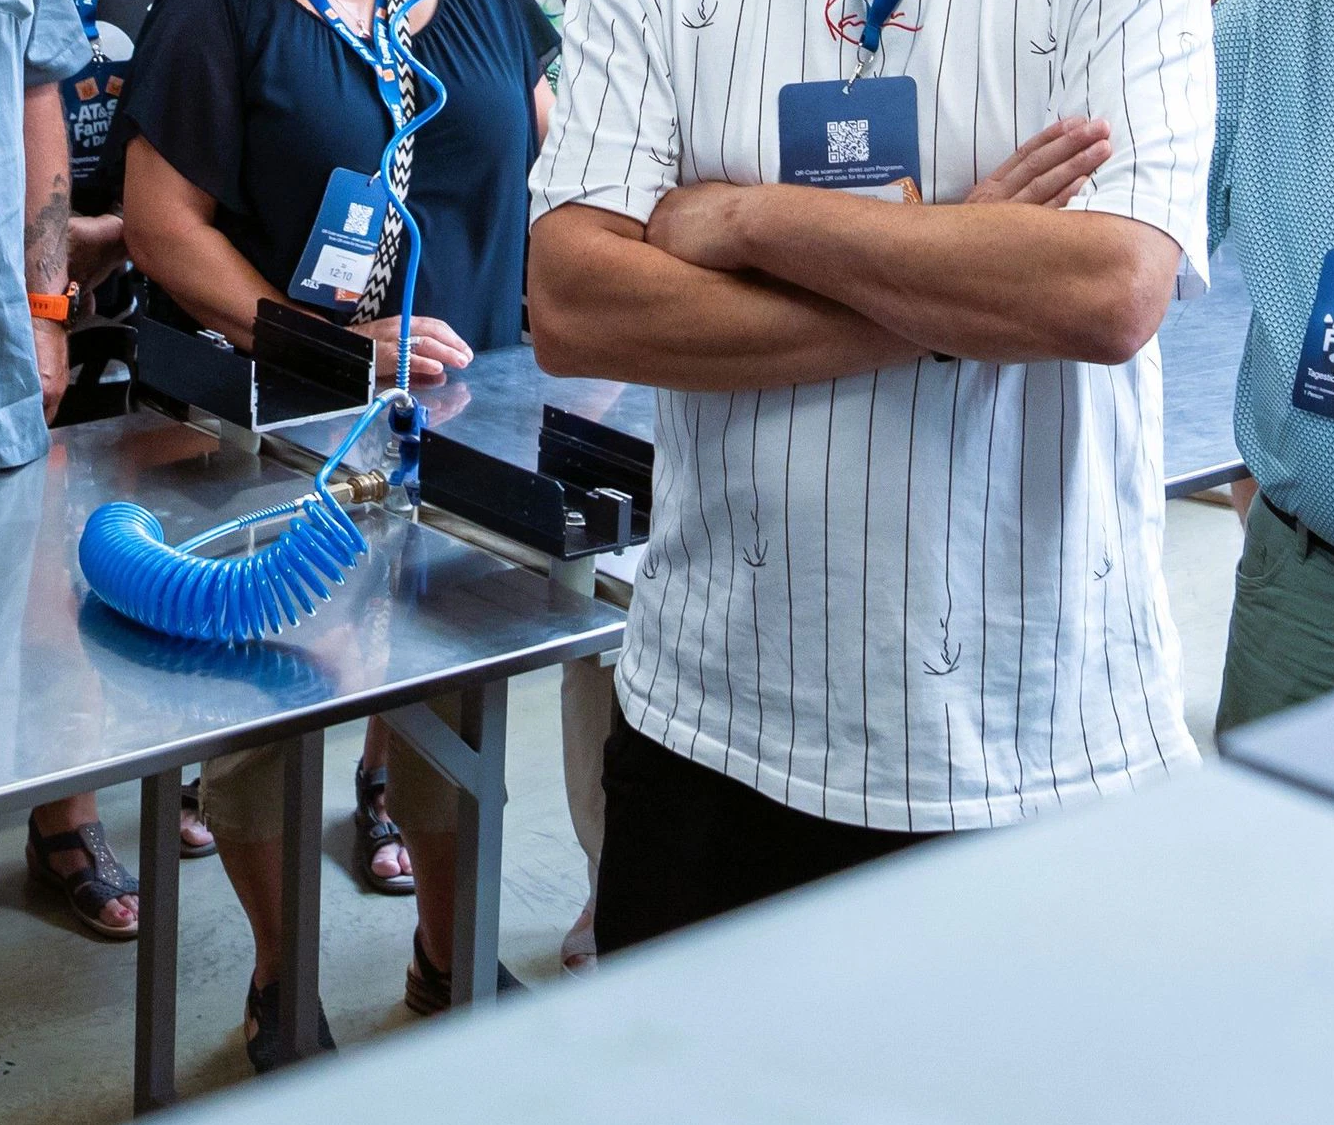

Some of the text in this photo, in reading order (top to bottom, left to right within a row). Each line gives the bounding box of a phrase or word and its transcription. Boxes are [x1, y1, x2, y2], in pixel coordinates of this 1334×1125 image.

[335, 23, 364, 49] Family
[74, 115, 112, 142] Fam
[330, 267, 353, 282] 12:10
